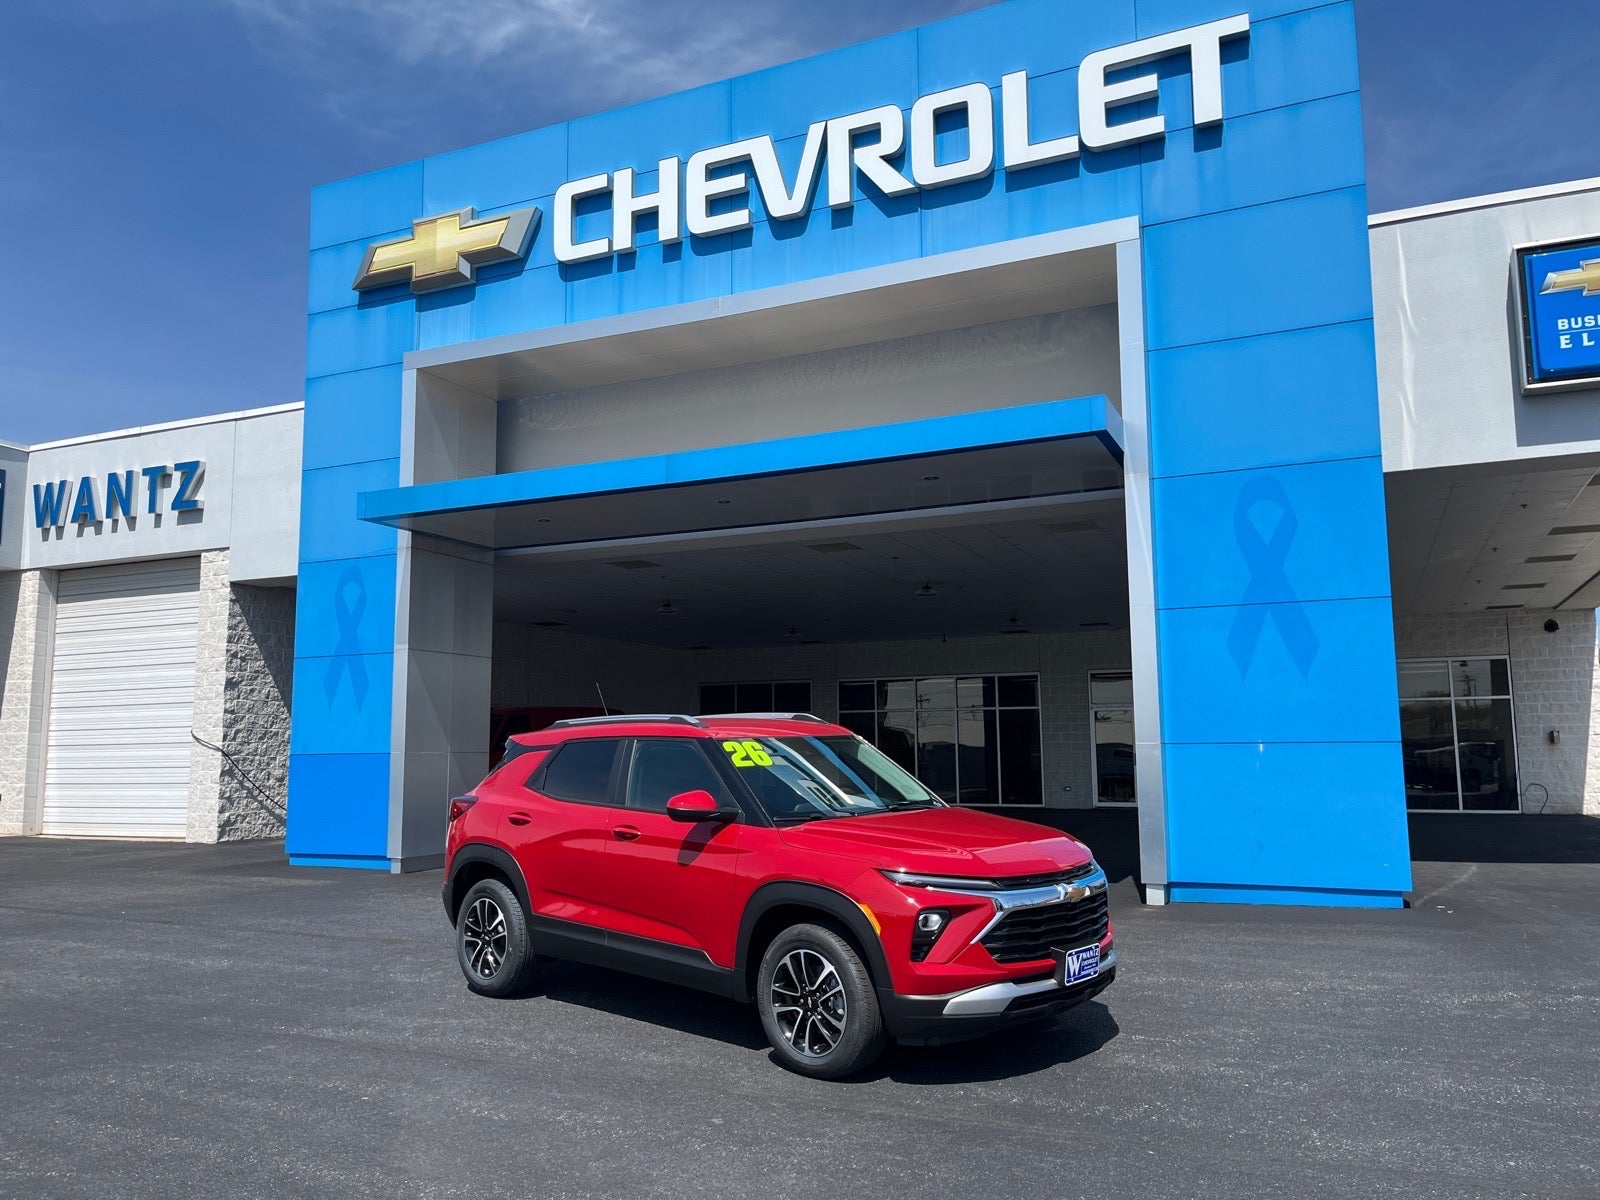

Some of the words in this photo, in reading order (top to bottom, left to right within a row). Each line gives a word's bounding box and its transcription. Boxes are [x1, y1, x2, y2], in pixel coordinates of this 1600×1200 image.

[553, 13, 1250, 264] CHEVROLET
[33, 460, 207, 529] WANTZ
[723, 741, 773, 767] 26
[1082, 948, 1099, 959] WANTZ
